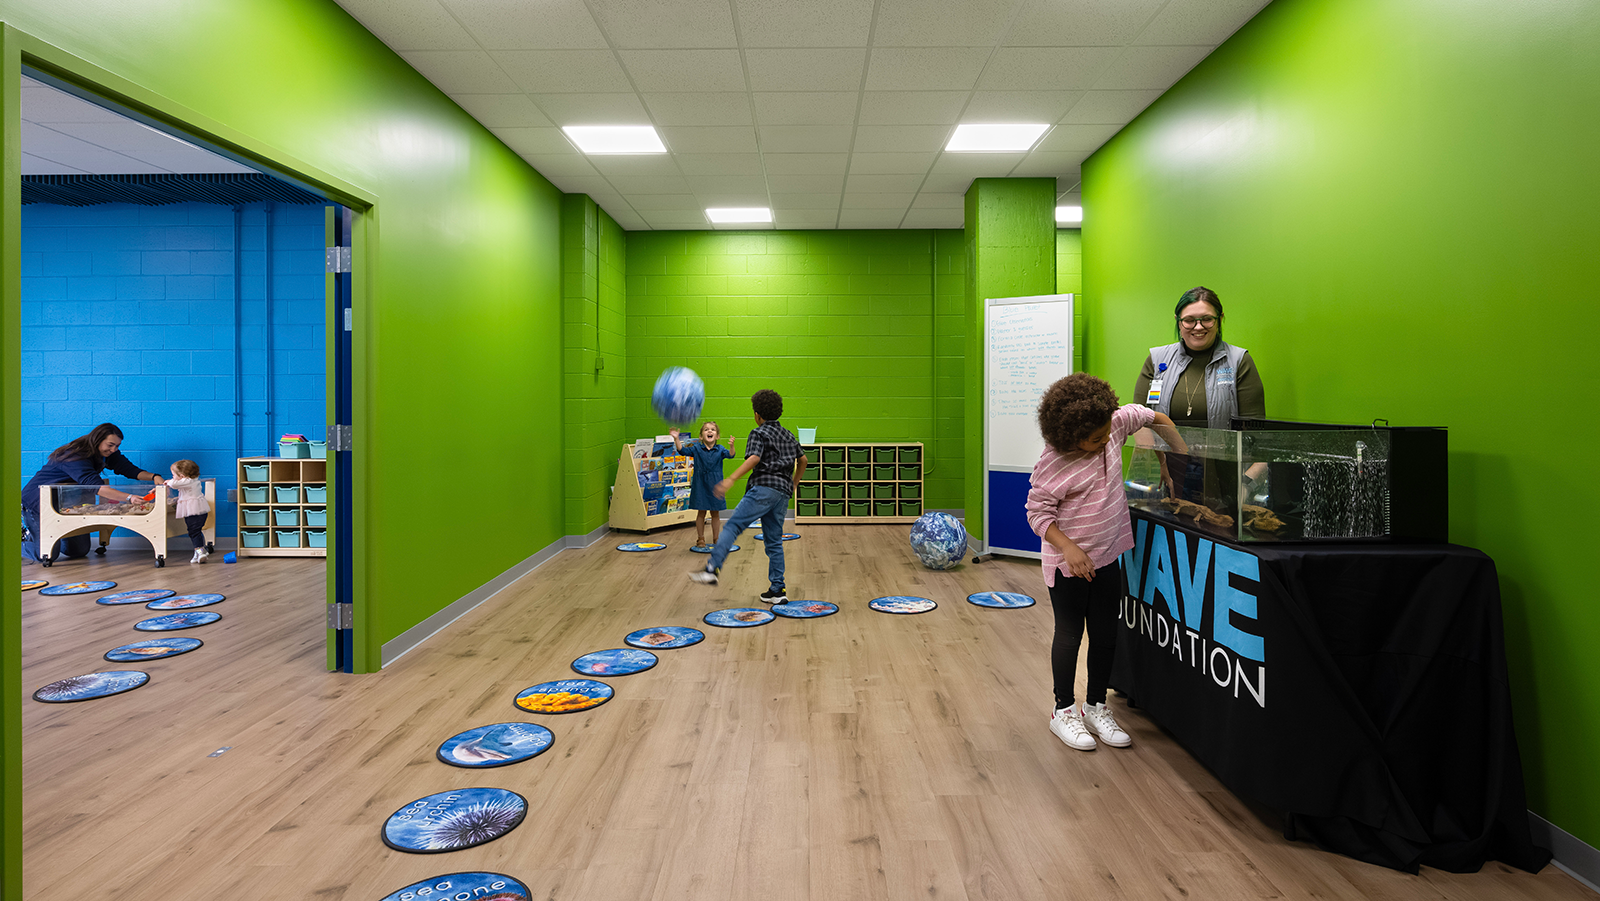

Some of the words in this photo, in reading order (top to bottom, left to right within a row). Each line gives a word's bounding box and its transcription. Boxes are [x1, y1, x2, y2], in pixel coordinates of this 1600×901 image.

[1118, 595, 1265, 708] UNDATION
[398, 801, 430, 821] sea
[416, 793, 462, 828] urchin
[399, 881, 452, 901] sea
